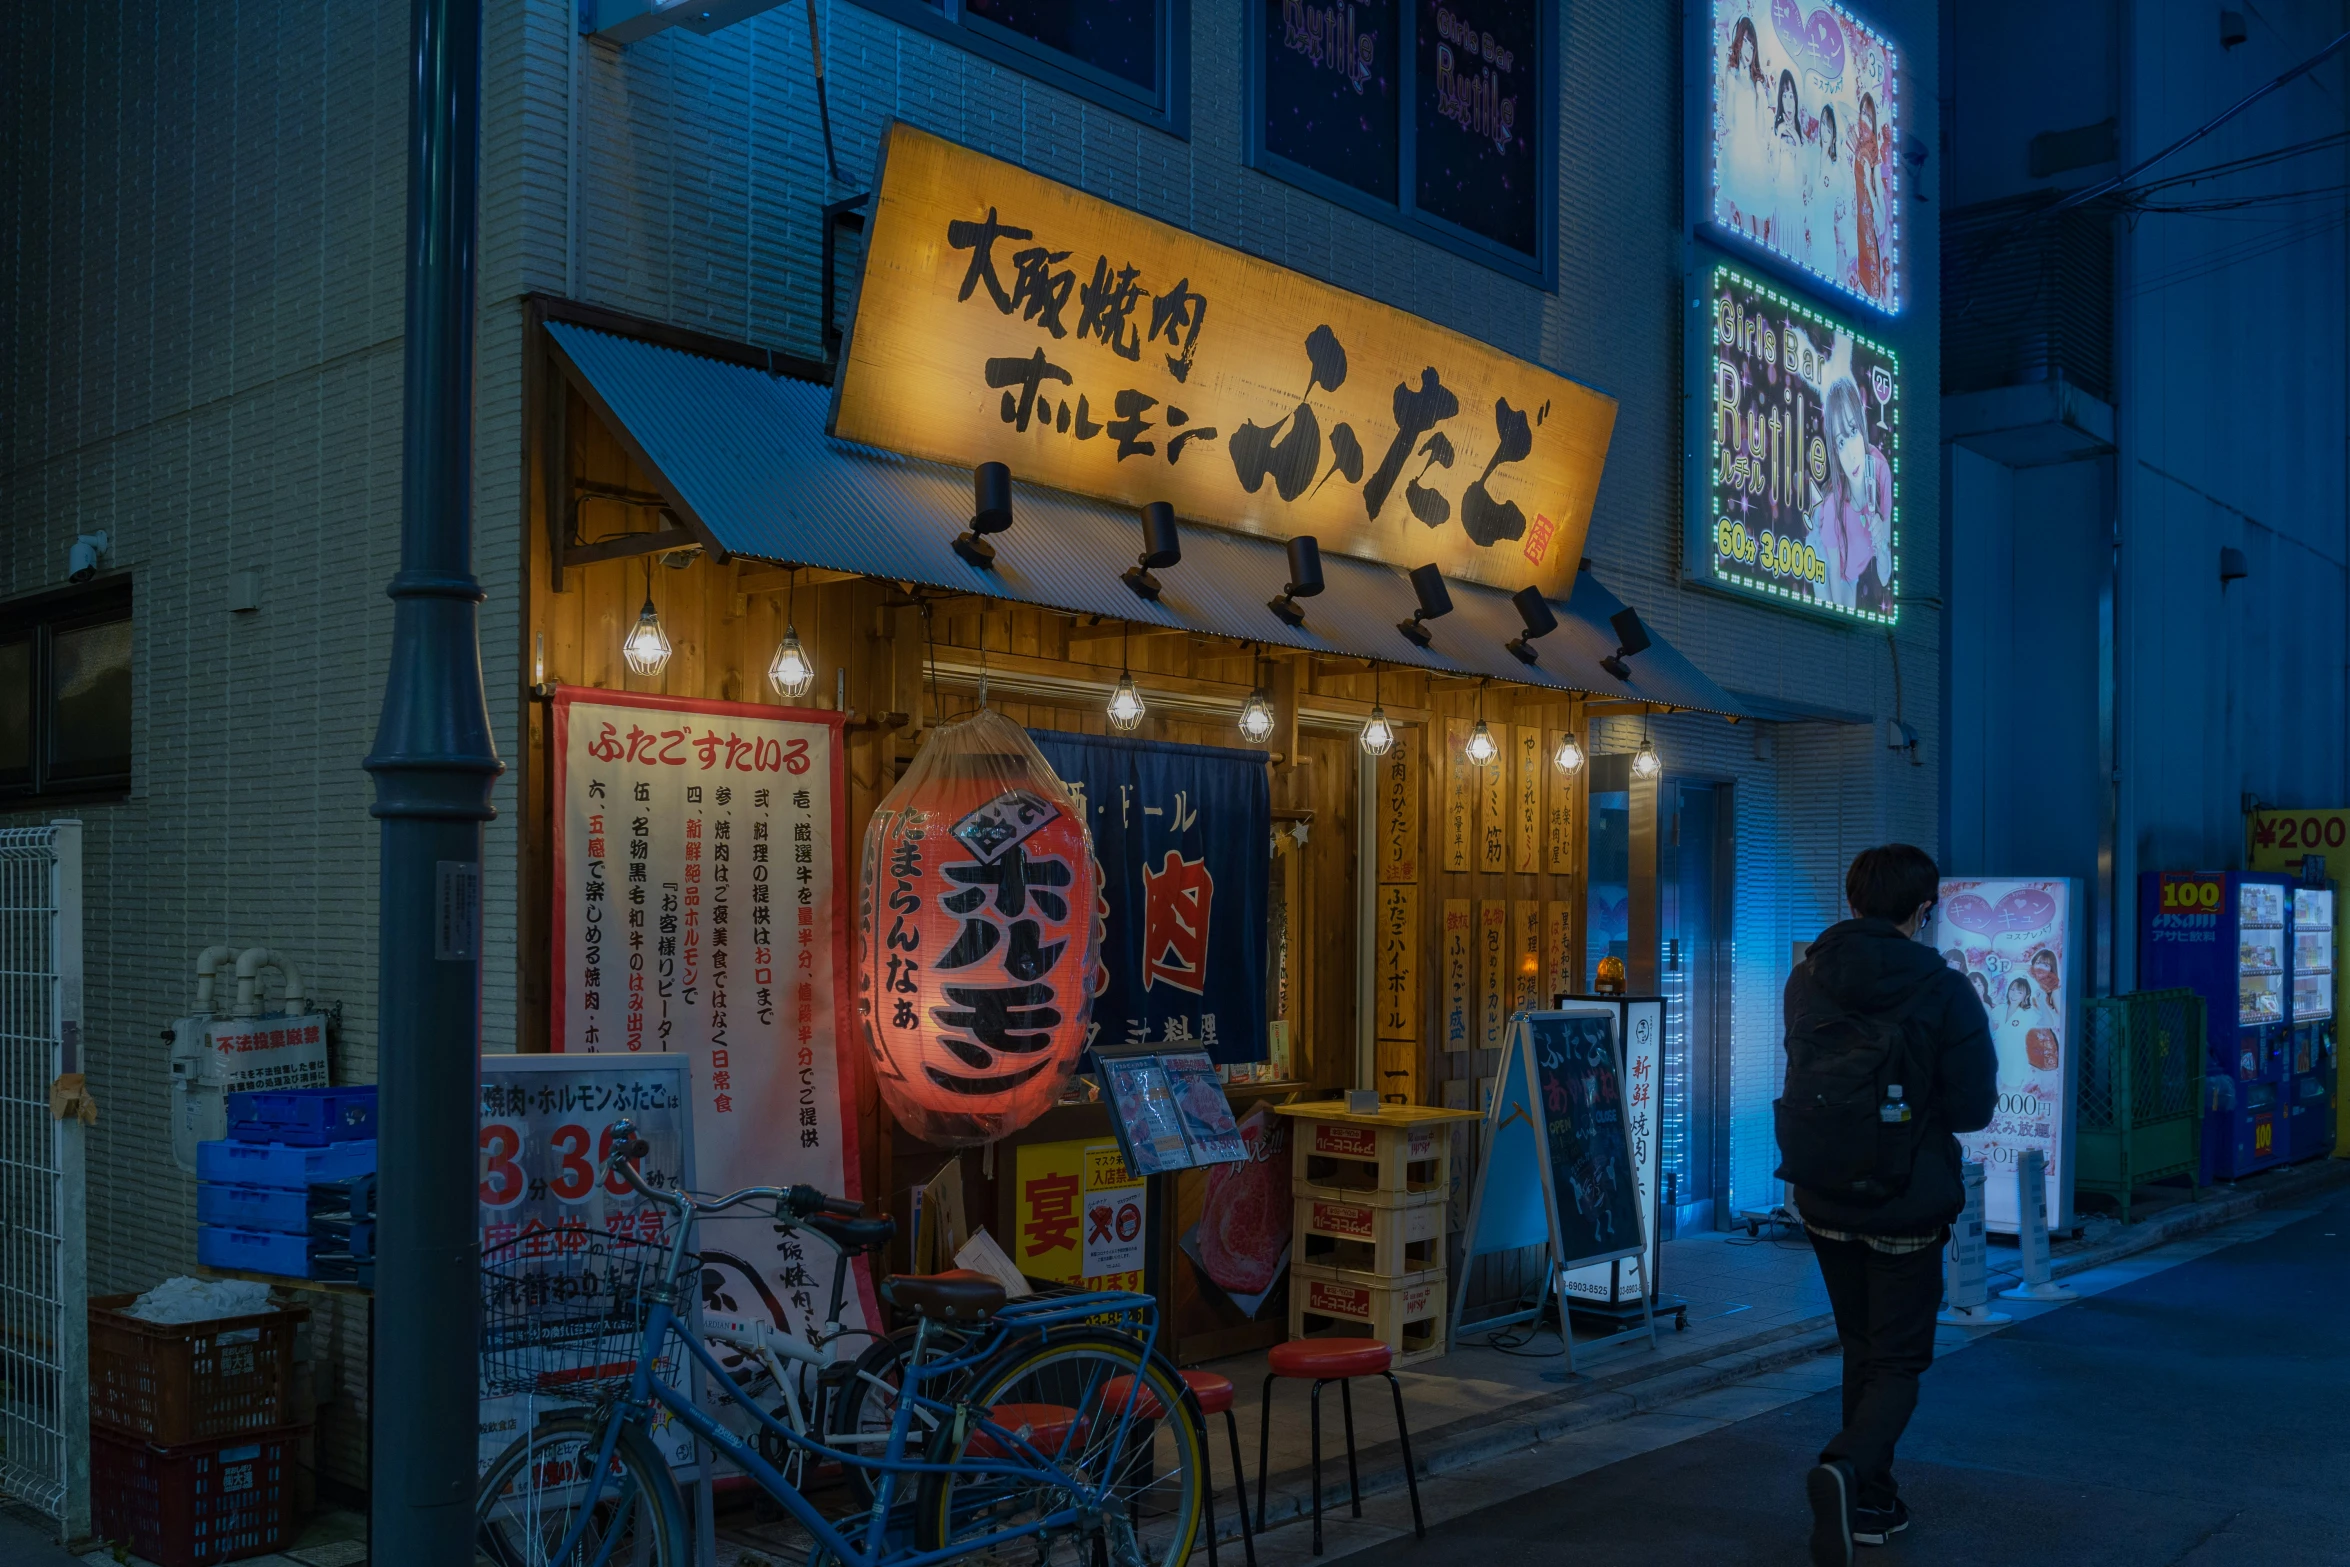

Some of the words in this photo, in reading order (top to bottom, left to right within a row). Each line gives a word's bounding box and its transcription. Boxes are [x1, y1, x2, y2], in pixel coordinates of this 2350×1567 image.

[1437, 8, 1479, 55] Girls
[1482, 31, 1514, 72] Bar
[1437, 42, 1513, 141] Rutile
[947, 206, 1208, 384] 大阪焼肉
[1720, 299, 1777, 364] Girls
[1783, 325, 1827, 385] Bar
[985, 346, 1219, 466] ホルモン
[1875, 374, 1890, 398] 2F
[1719, 360, 1827, 512] Rutile
[1719, 449, 1765, 493] ルチル
[1718, 518, 1757, 563] 60分
[1760, 530, 1827, 584] 3,000円
[588, 721, 811, 775] ふたごすたいる
[682, 786, 702, 1005] 四、新鮮絶品ホルモンで
[752, 789, 773, 1026] 弐、料理の提供はお口まで
[2164, 882, 2220, 907] 100
[627, 781, 650, 1051] 伍、名物黒毛和牛のはみ出る
[886, 806, 925, 1031] たまらんなぁ
[1484, 908, 1505, 928] 名物
[1950, 903, 1992, 929] キュン
[1998, 902, 2050, 929] キュン
[711, 786, 733, 1113] 参、焼肉はご褒美食ではなく日常食
[2152, 930, 2216, 942] アサヒ飲料
[1387, 889, 1410, 1030] ふたごハイボール
[1988, 956, 2010, 973] 3F
[216, 1025, 320, 1055] 不法投棄厳禁
[480, 1082, 679, 1118] 焼肉・ホルモンふたごは
[1595, 1109, 1617, 1123] CLOSE
[1316, 1136, 1375, 1156] アサヒビール
[1411, 1140, 1430, 1156] Asahi
[1093, 1166, 1138, 1187] 入店禁
[1024, 1172, 1080, 1257] 宴
[1313, 1214, 1373, 1234] アサヒビール
[1311, 1293, 1368, 1315] アサヒビール
[1406, 1299, 1426, 1314] Asahi
